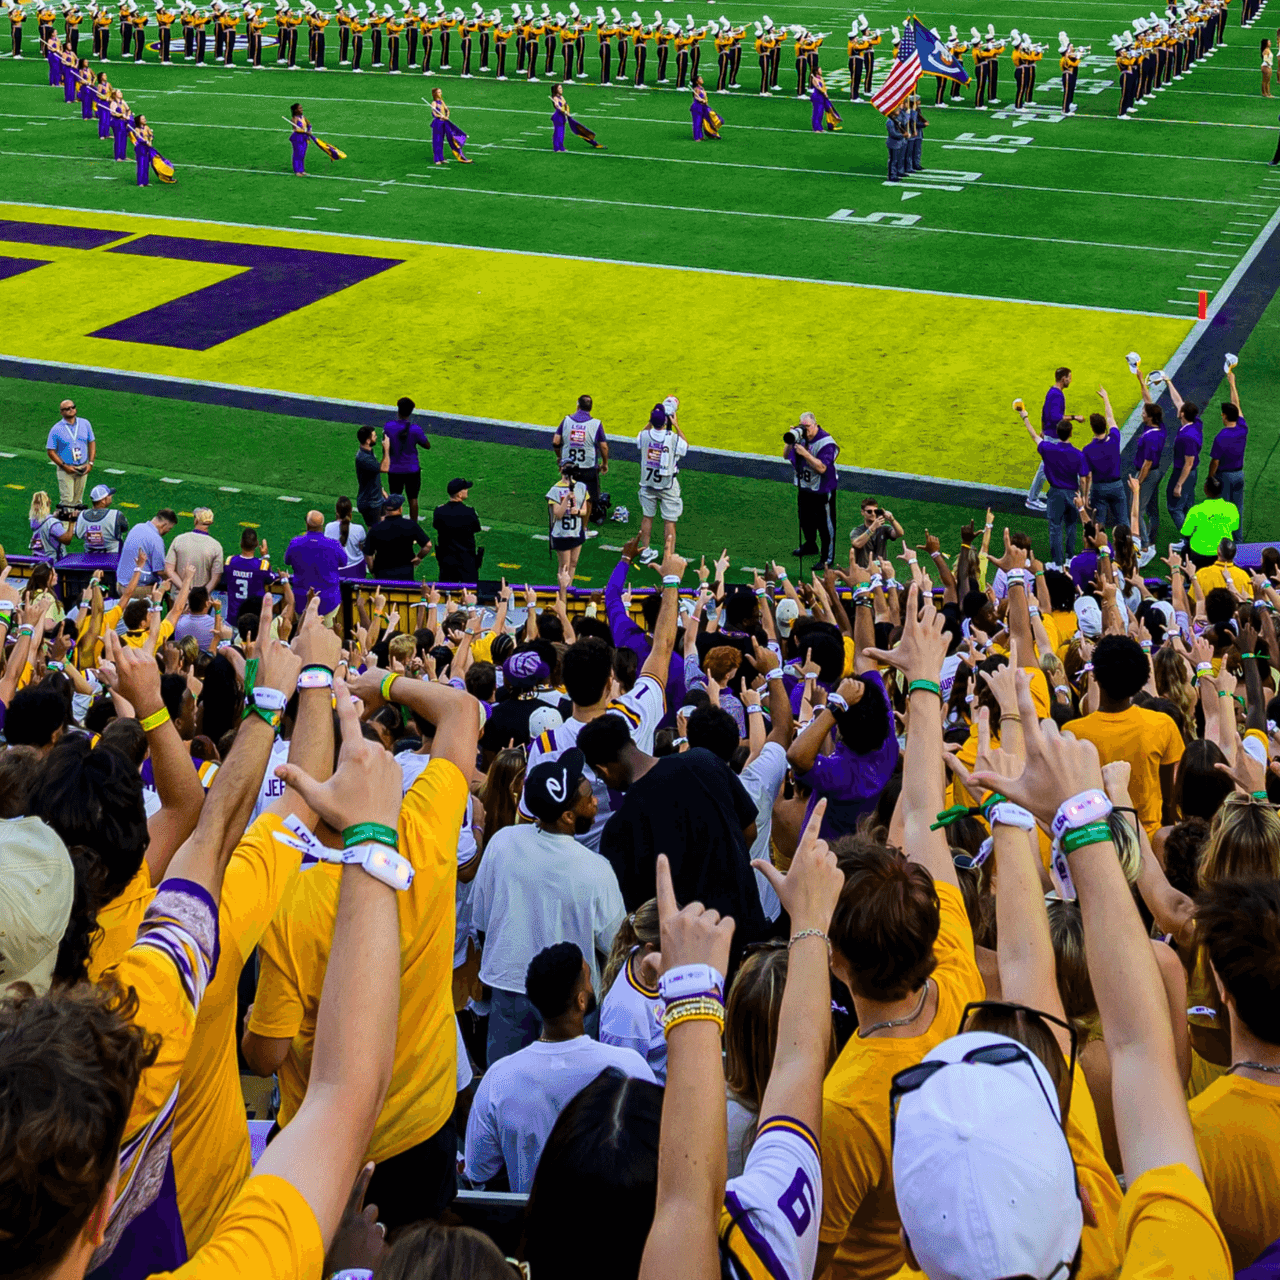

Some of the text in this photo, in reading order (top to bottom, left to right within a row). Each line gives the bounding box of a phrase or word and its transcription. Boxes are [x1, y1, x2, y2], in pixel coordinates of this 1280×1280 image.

[569, 449, 586, 462] 83
[646, 468, 662, 483] 79
[235, 579, 249, 599] 3
[635, 685, 650, 700] 1
